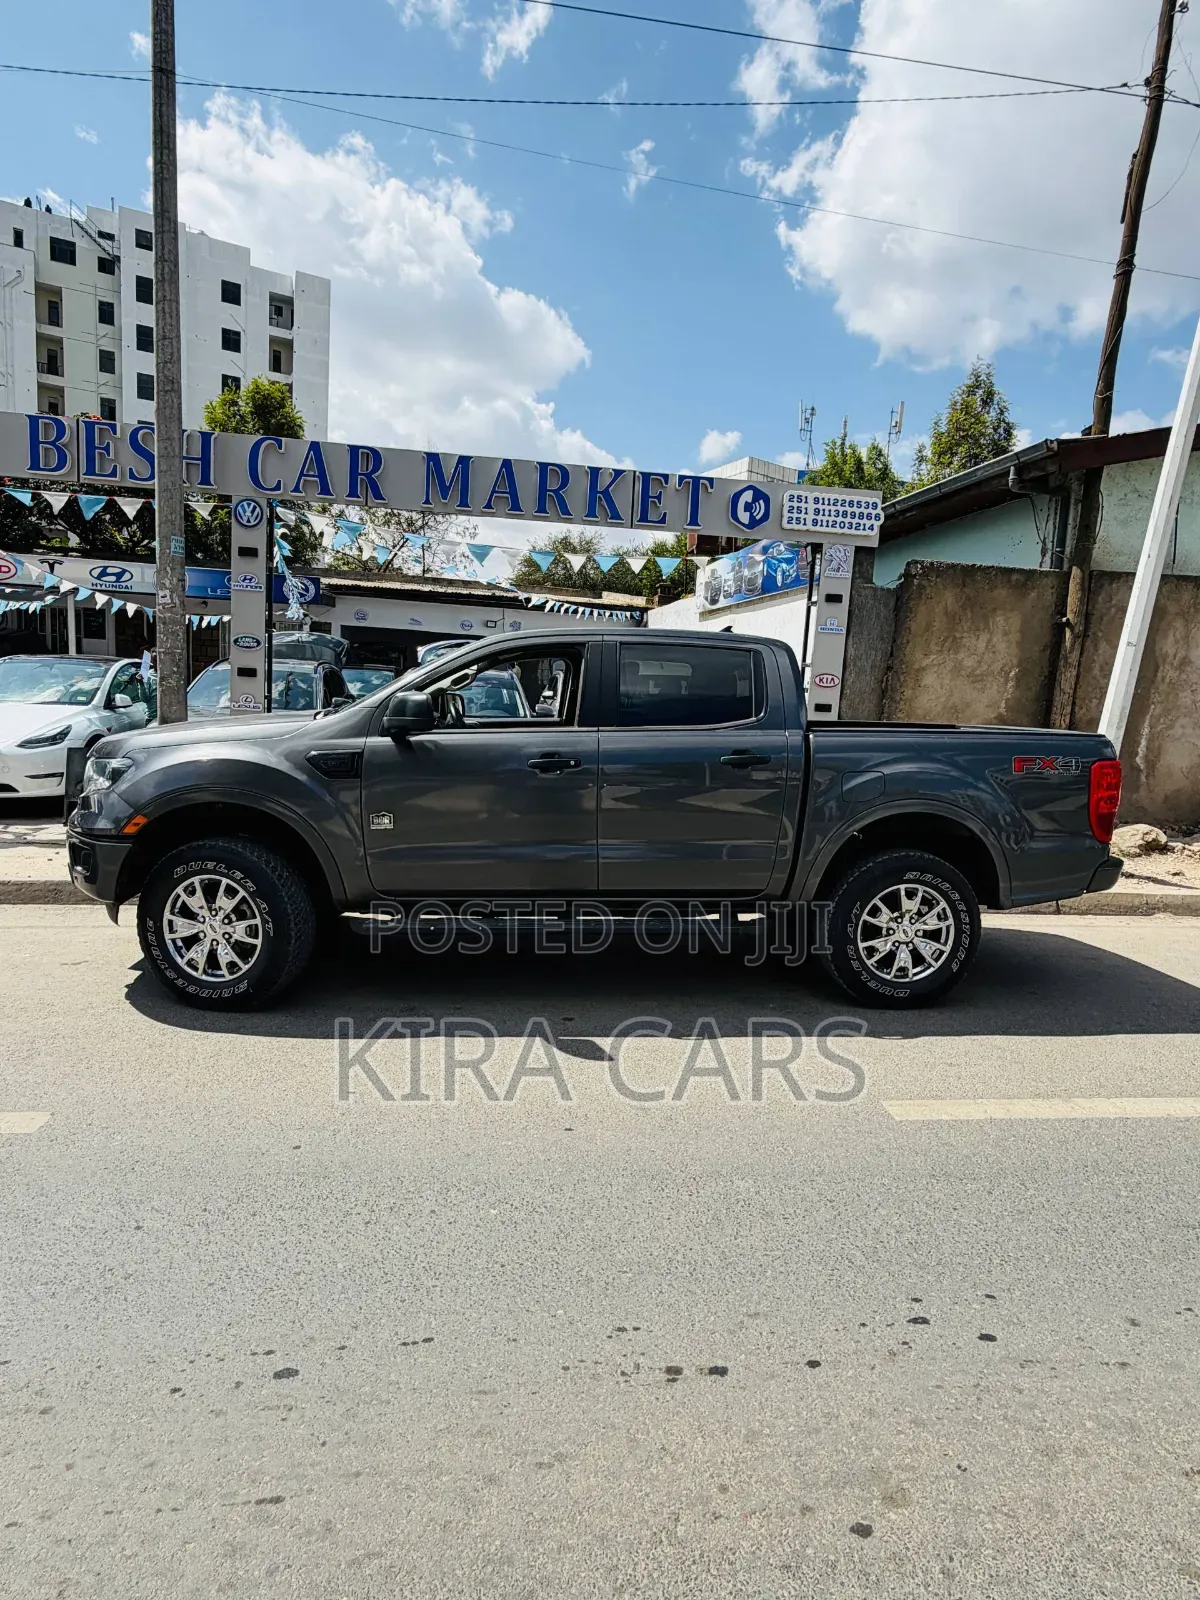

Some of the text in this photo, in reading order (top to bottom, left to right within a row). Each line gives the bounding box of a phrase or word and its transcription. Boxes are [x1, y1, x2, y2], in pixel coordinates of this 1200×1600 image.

[247, 436, 388, 503] CAR
[420, 451, 715, 530] MARKET
[788, 494, 879, 511] 251 911226539
[787, 505, 882, 522] 251 911389866
[786, 516, 875, 532] 251 911203214
[91, 582, 133, 590] HYUNDAI
[1012, 756, 1082, 775] FX4
